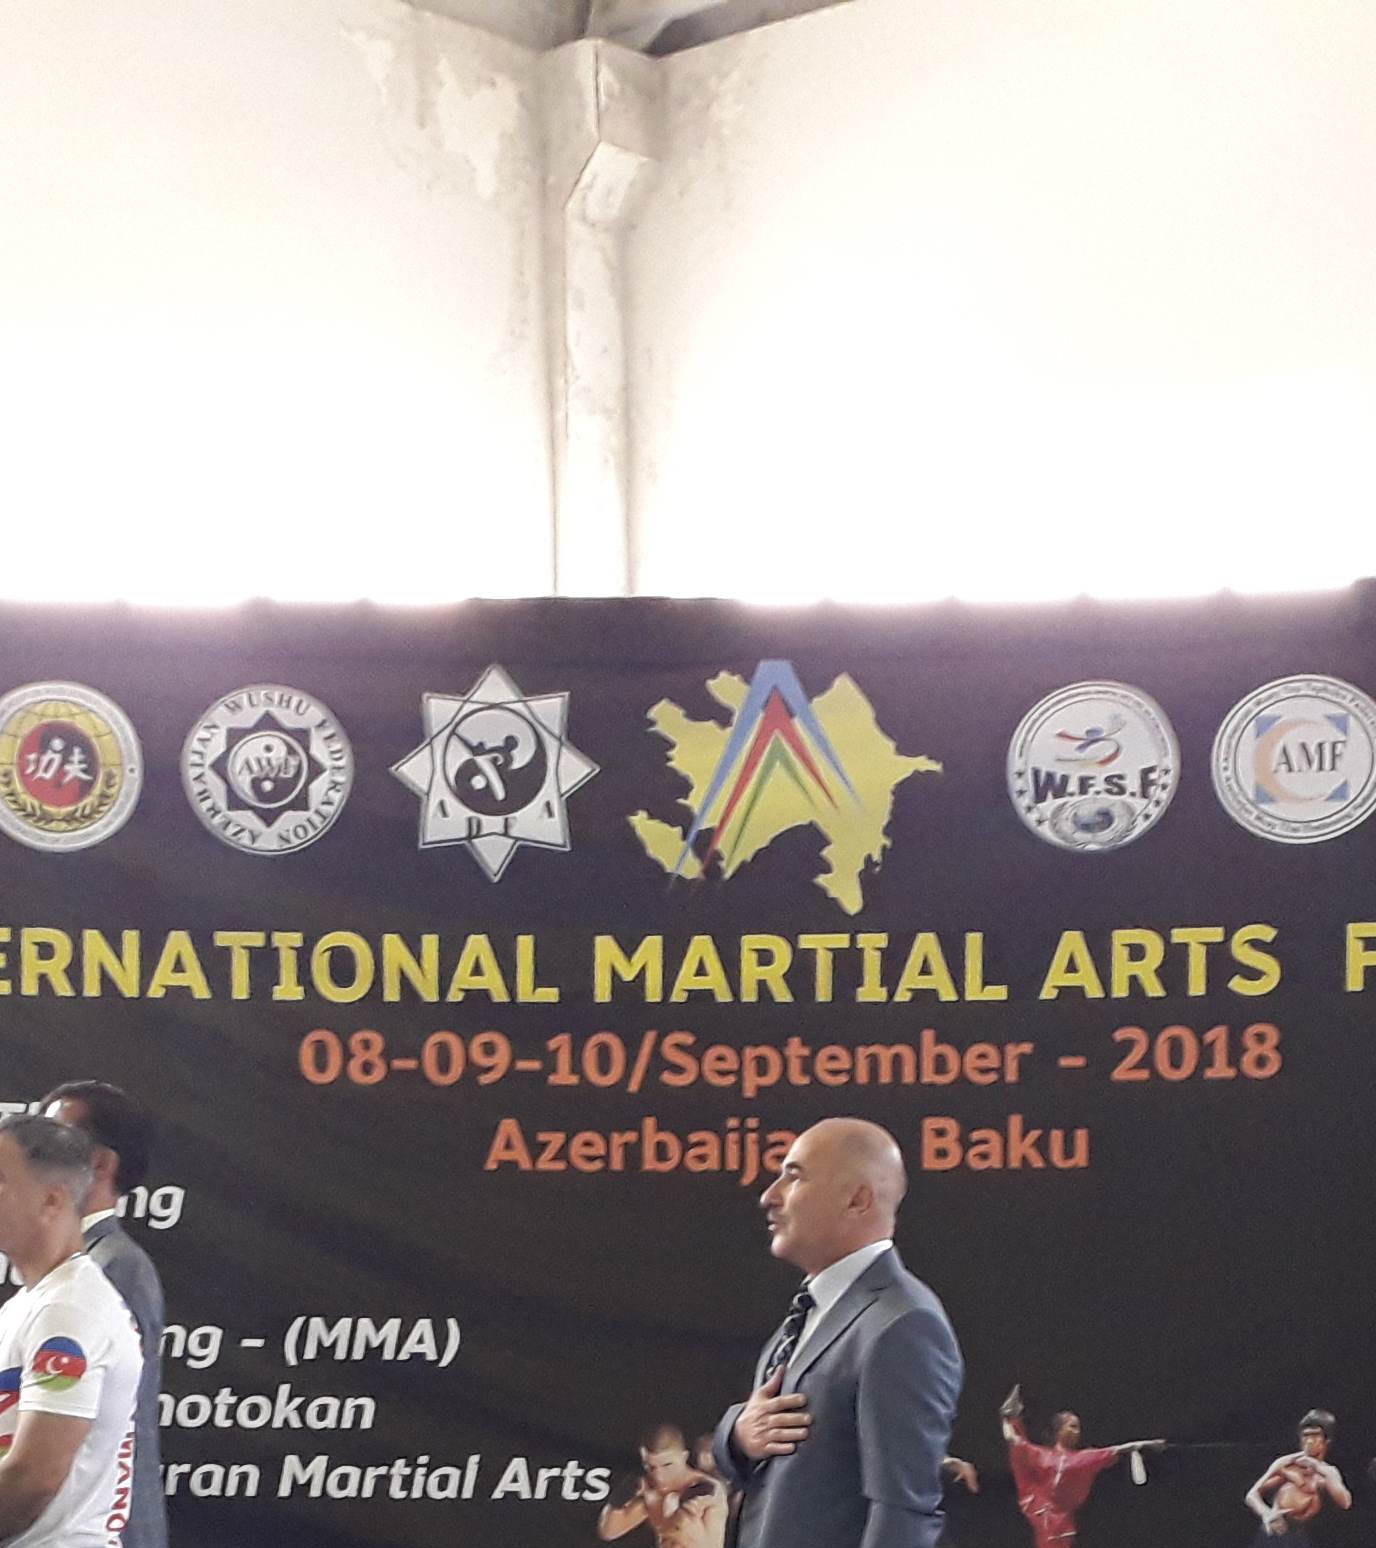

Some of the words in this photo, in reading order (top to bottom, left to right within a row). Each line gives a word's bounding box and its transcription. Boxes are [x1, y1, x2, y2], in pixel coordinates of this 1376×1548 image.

[594, 933, 1008, 1002] MARTIAL
[1040, 925, 1282, 999] ARTS
[299, 1029, 1033, 1098] 08-09-10/September
[1111, 1022, 1283, 1081] 2018
[484, 1115, 798, 1187] Azerbaija
[922, 1114, 1090, 1171] Baku
[284, 1315, 461, 1368] (MMA)
[277, 1454, 482, 1500] Martial
[490, 1456, 612, 1501] Arts
